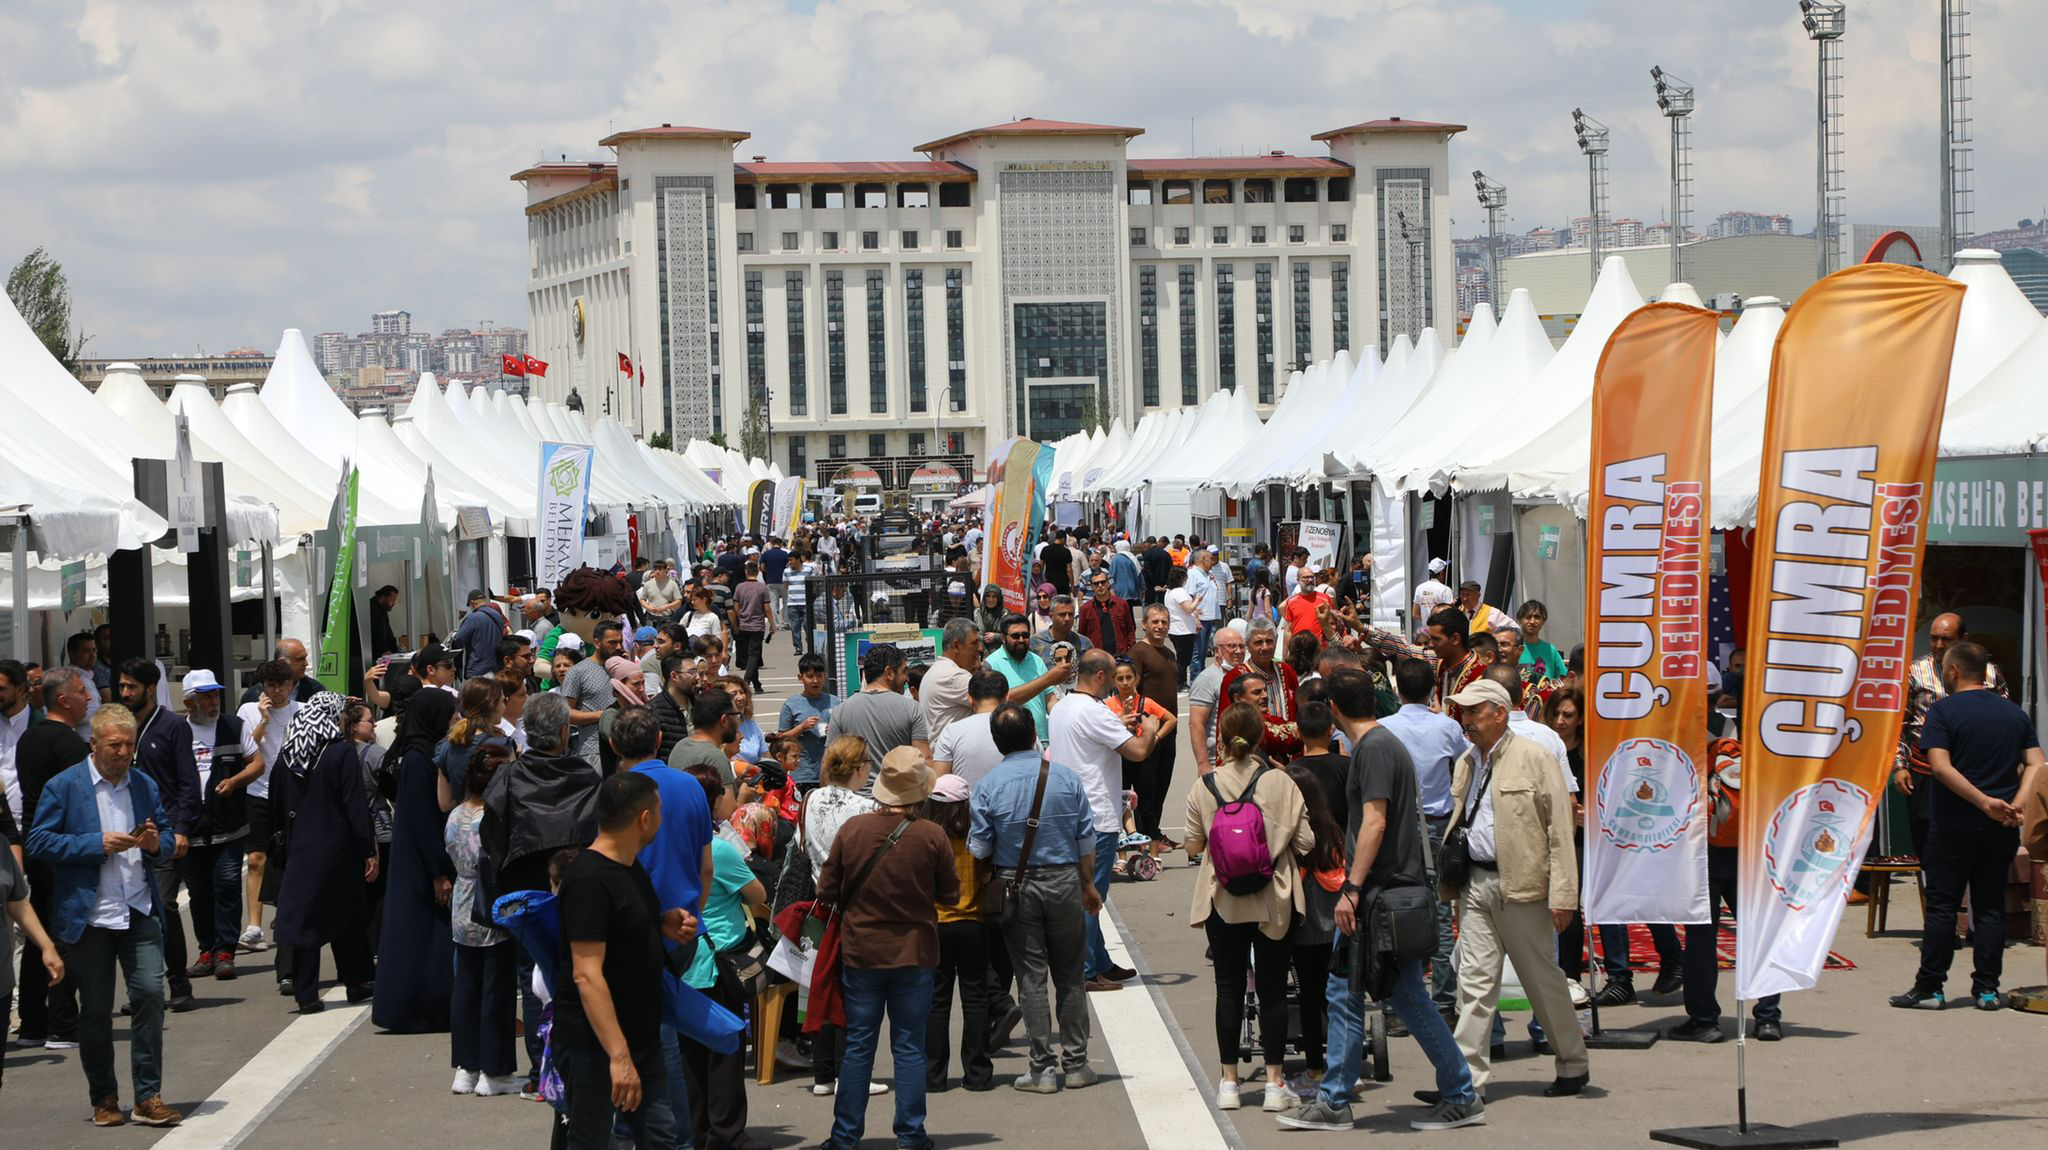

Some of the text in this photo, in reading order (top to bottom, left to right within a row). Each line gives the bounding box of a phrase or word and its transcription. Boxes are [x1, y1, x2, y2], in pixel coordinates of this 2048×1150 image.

[557, 502, 573, 584] MERAM
[1595, 453, 1672, 720] ÇUMRA
[1657, 481, 1702, 680] BELEDİYESİ
[1760, 446, 1879, 759] ÇUMRA
[1853, 482, 1924, 712] BELEDİYESİ
[1927, 480, 2048, 534] KŞEHİR BE
